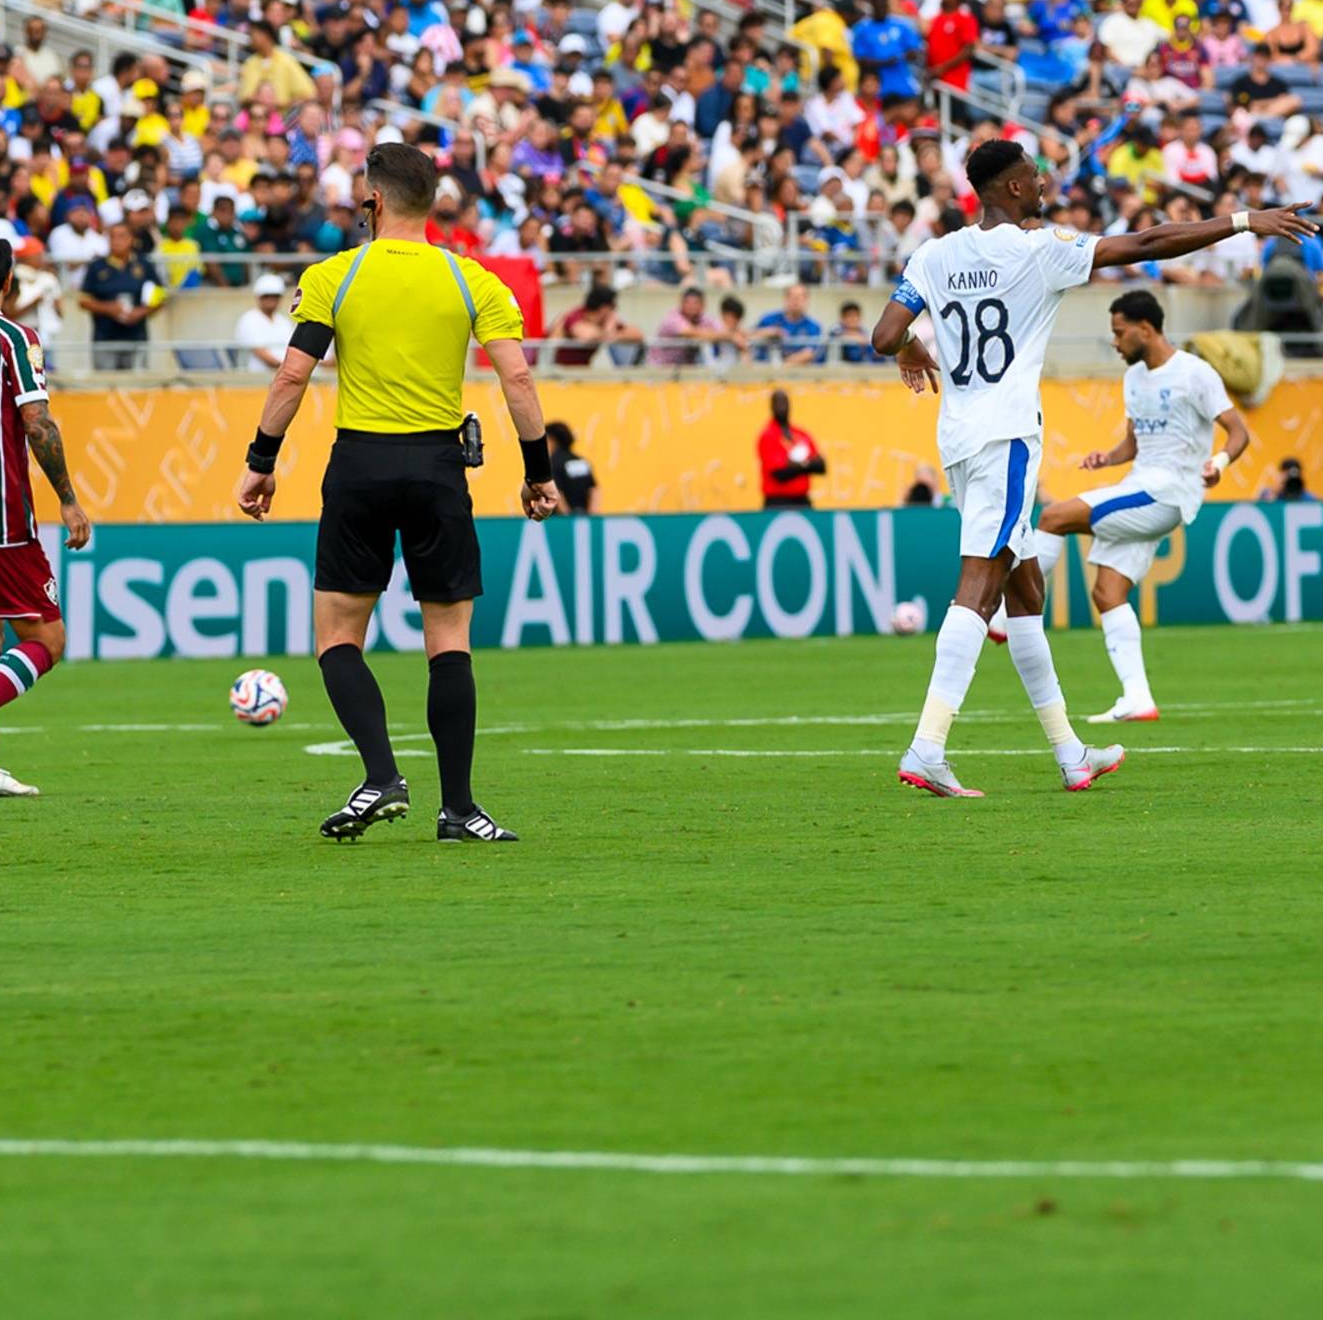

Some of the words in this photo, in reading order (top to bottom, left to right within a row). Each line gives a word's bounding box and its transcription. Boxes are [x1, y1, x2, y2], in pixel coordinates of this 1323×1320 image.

[947, 270, 998, 290] KANNO
[940, 298, 1015, 386] 28
[501, 517, 659, 648] AIR
[1214, 503, 1323, 623] OF
